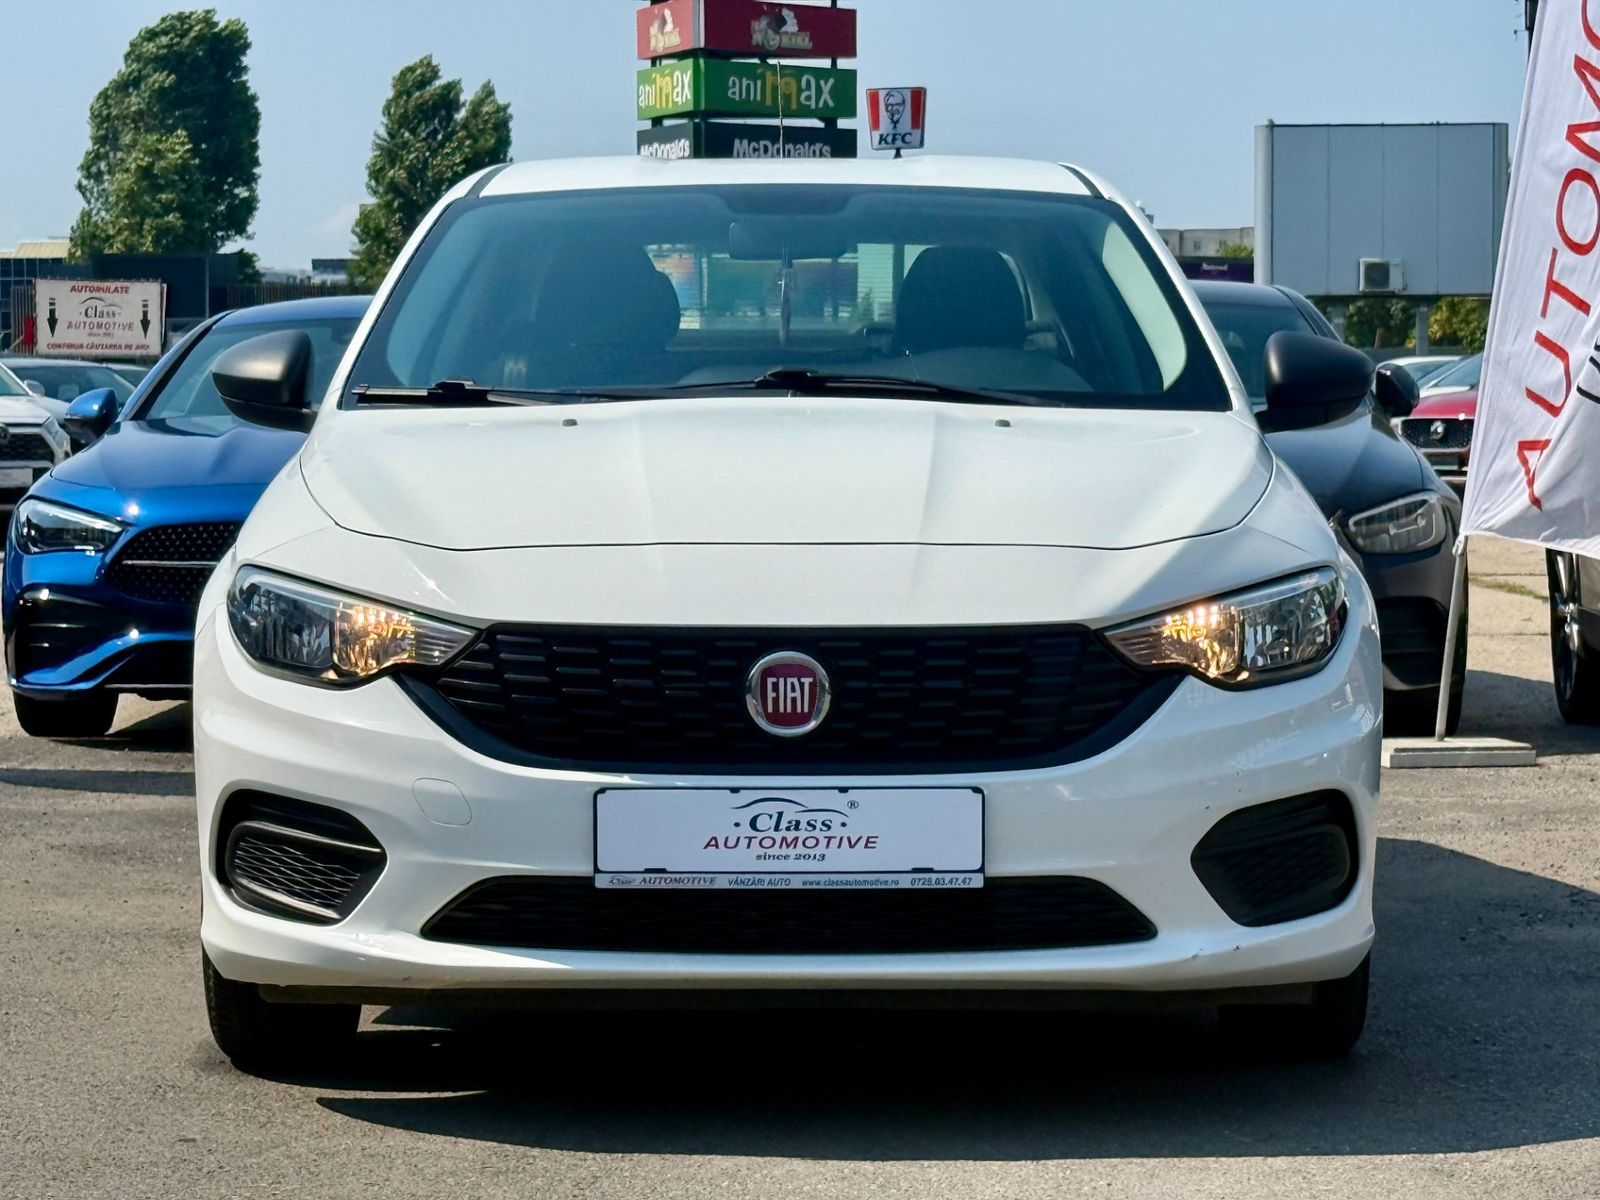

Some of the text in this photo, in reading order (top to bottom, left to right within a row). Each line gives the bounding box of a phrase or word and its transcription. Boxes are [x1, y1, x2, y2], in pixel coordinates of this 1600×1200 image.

[639, 69, 692, 108] animax
[728, 68, 835, 109] animax
[733, 138, 831, 158] McDonald's
[878, 132, 913, 146] KFC
[1516, 0, 1600, 512] AUTOM
[66, 321, 134, 331] AUTOMOTIVE
[767, 677, 813, 713] FIAT
[749, 811, 832, 832] Class
[703, 836, 879, 849] AUTOMOTIVE
[755, 852, 825, 862] since 2013
[639, 876, 716, 885] AUTOMOTIVE
[767, 878, 791, 887] AUTO
[802, 877, 899, 887] www.classautomotive.ro
